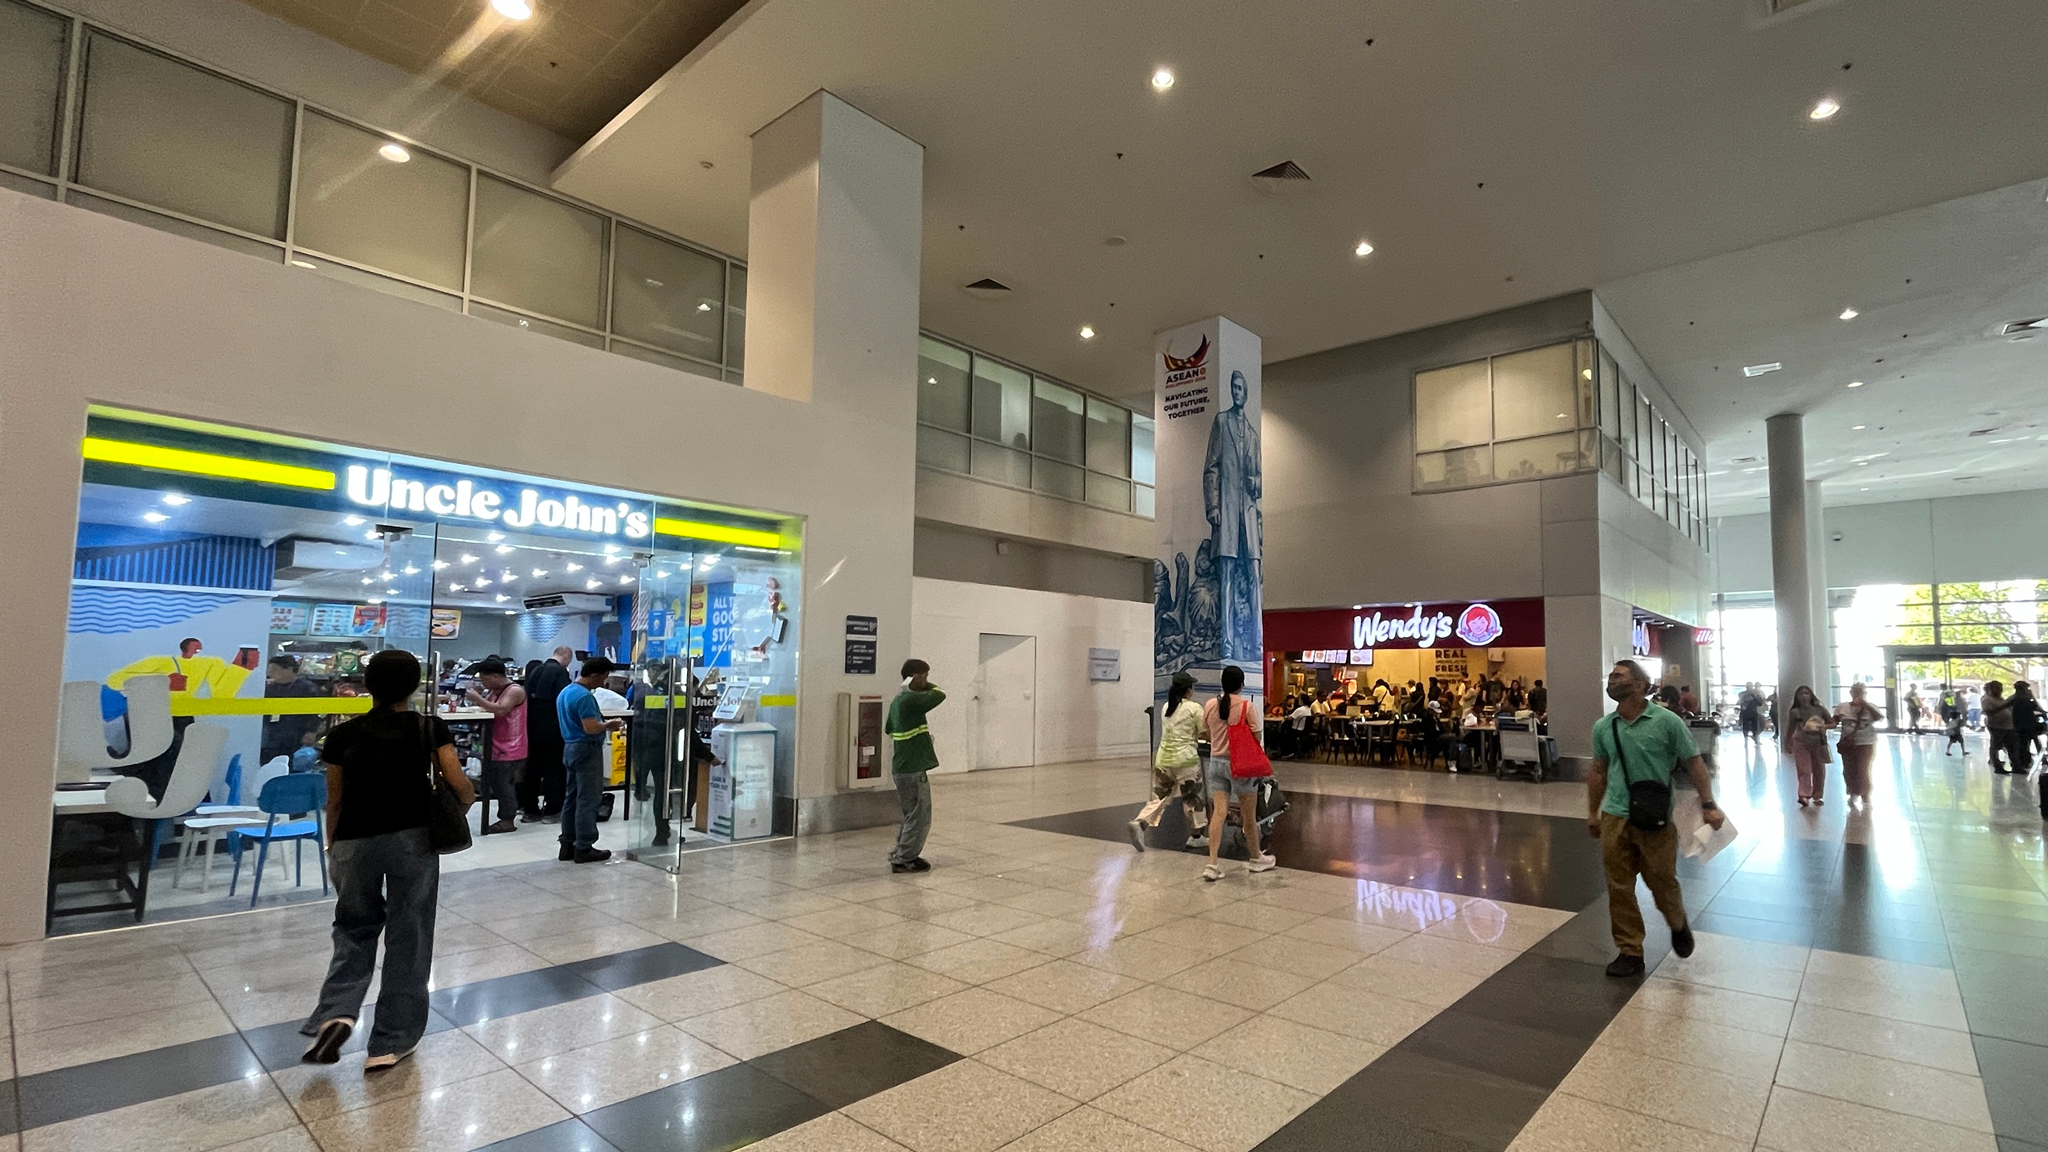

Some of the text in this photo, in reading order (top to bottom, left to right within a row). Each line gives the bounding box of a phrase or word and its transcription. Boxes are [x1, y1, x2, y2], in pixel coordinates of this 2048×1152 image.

[1166, 369, 1199, 384] ASEAN
[1165, 387, 1208, 403] NAVIGATING
[1164, 397, 1209, 411] OUR FUTURE,
[1168, 406, 1205, 419] TOGETHER
[346, 465, 649, 538] Uncle John's
[713, 596, 735, 609] ALL T
[712, 610, 735, 626] GOO
[1353, 603, 1453, 649] Wendy's
[712, 627, 735, 642] STU
[1435, 649, 1467, 659] REAL
[1435, 664, 1467, 673] FRESH
